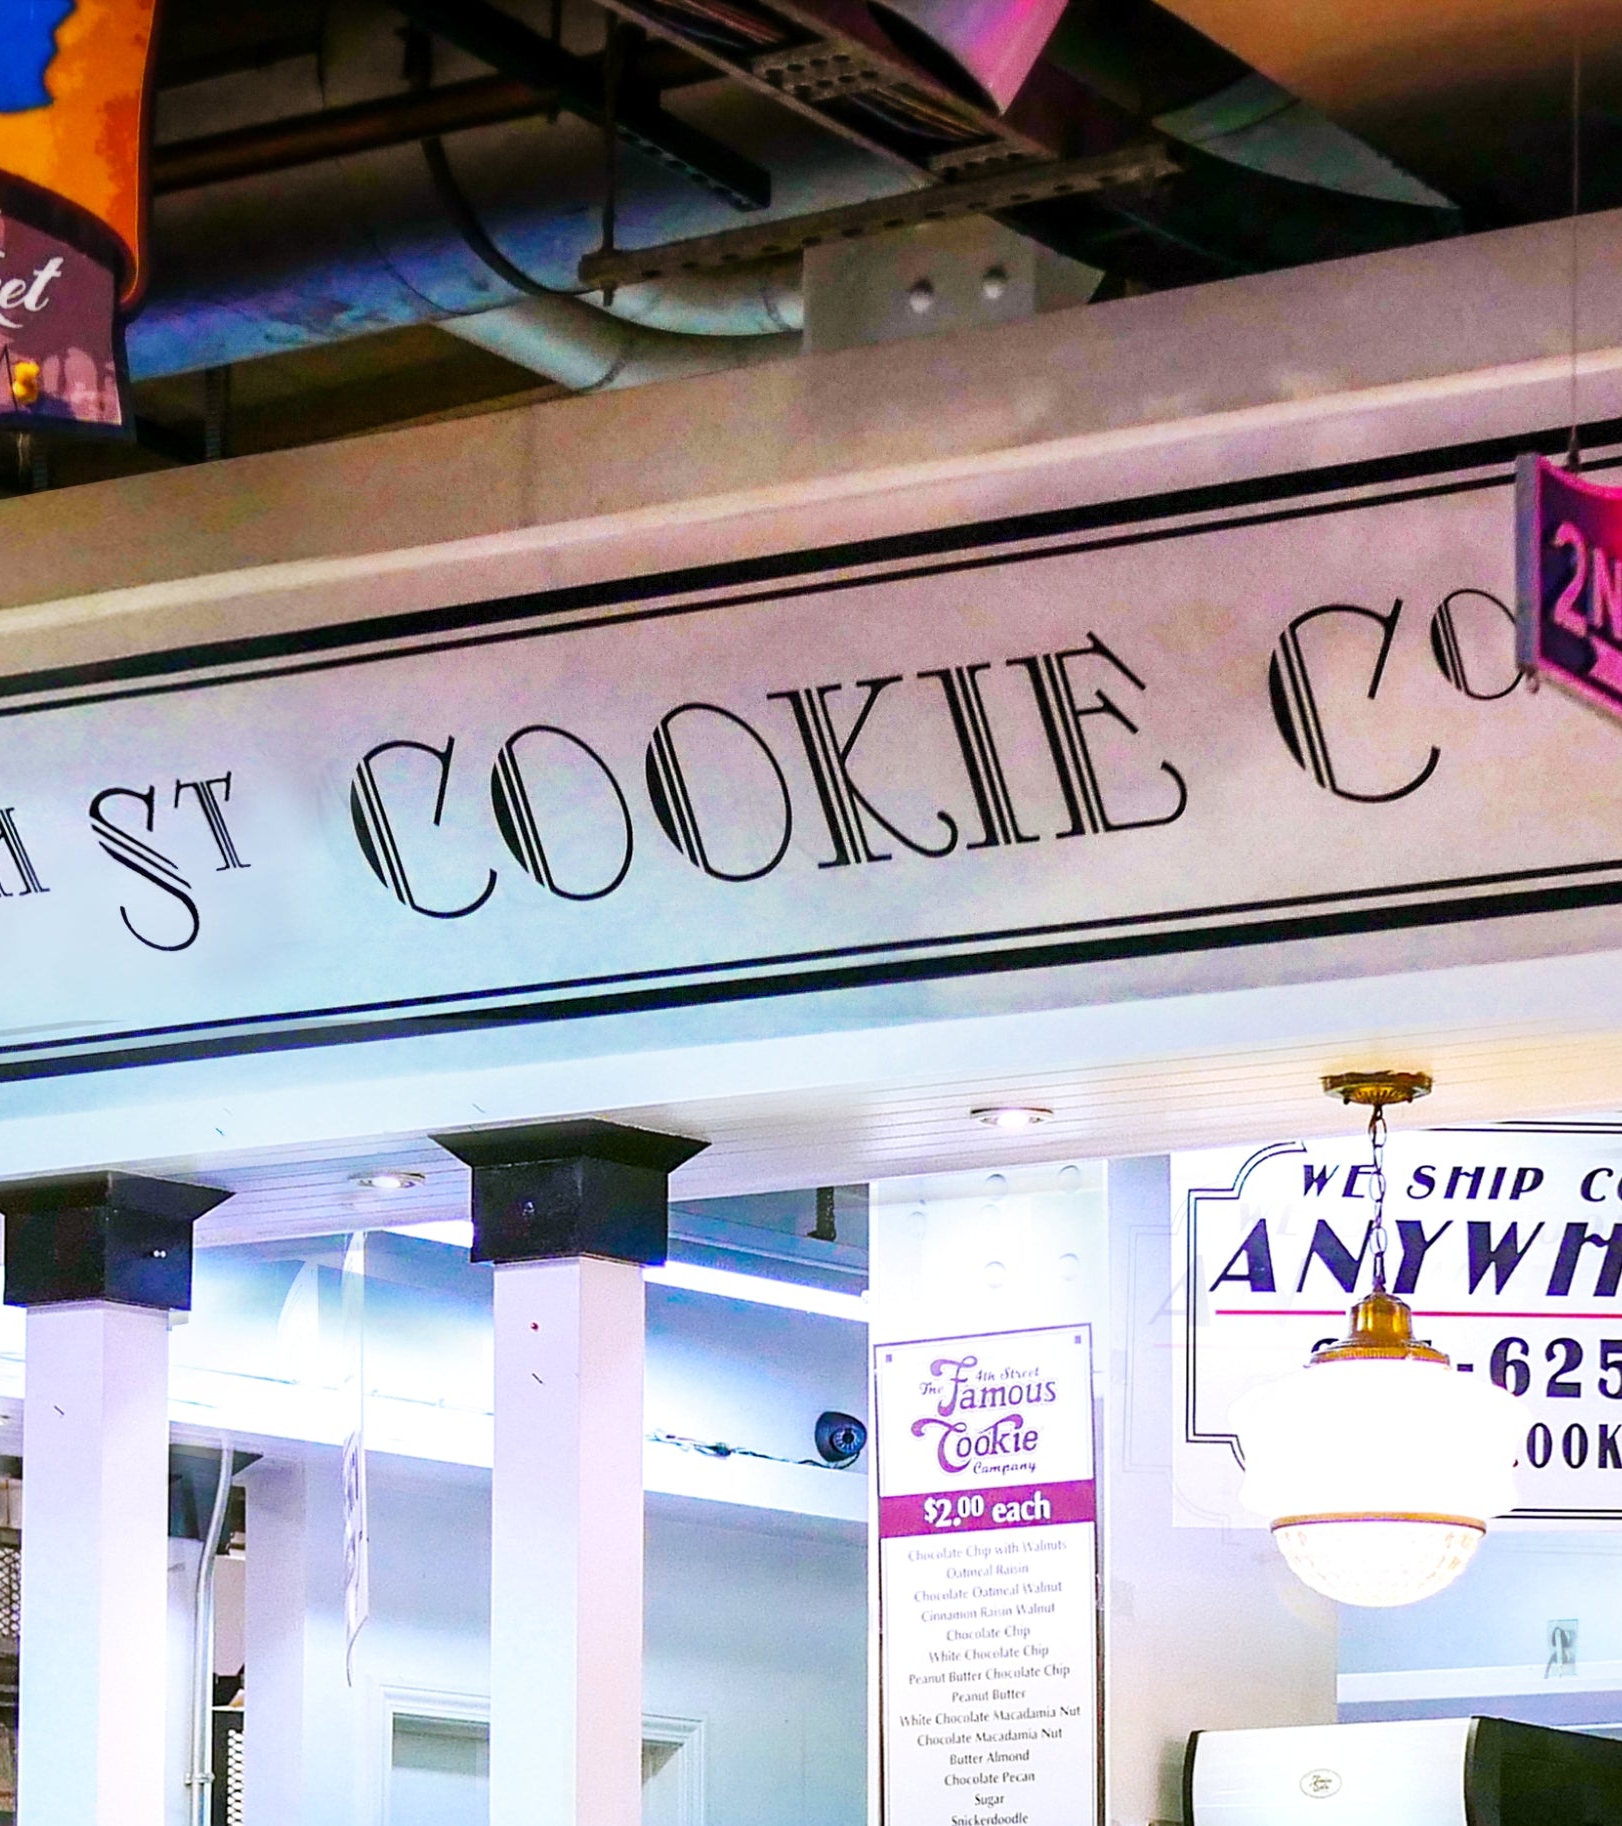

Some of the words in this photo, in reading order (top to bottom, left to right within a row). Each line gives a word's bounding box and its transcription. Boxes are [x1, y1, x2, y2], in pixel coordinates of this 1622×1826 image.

[90, 771, 250, 952] ST
[349, 631, 1187, 921] COOKIE
[1303, 1163, 1371, 1198] WE
[1407, 1165, 1545, 1201] SHIP
[1000, 1367, 1039, 1381] Street
[930, 1356, 1057, 1417] Famous
[911, 1413, 1039, 1474] Cookie
[973, 1461, 1036, 1476] Company
[924, 1495, 985, 1528] $2.00
[992, 1490, 1051, 1523] each
[908, 1546, 962, 1562] Chocolate
[965, 1543, 991, 1560] Chip
[994, 1541, 1019, 1555] with
[1022, 1539, 1067, 1553] Walnuts
[946, 1564, 993, 1579] Oatmeal
[996, 1562, 1029, 1576] Raisin
[914, 1587, 969, 1603] Chocolate
[972, 1583, 1019, 1599] Oatmeal
[1022, 1581, 1062, 1595] Walnut
[921, 1608, 977, 1623] Cinnamon
[980, 1606, 1012, 1618] Raisin
[1016, 1602, 1055, 1616] Walnut
[946, 1627, 1001, 1642] Chocolate
[1004, 1625, 1031, 1640] Chip
[929, 1649, 961, 1664] White
[964, 1646, 1020, 1661] Chocolate
[1023, 1643, 1049, 1659] Chip
[908, 1673, 946, 1686] Peanut
[948, 1671, 982, 1683] Butter
[985, 1665, 1041, 1680] Chocolate
[1043, 1663, 1071, 1679] Chip
[951, 1690, 989, 1703] Peanut
[992, 1688, 1027, 1700] Butter
[899, 1714, 932, 1728] White
[935, 1711, 990, 1726] Chocolate
[992, 1705, 1057, 1722] Macadamia
[1060, 1706, 1081, 1717] Nut
[917, 1732, 972, 1747] Chocolate
[975, 1728, 1038, 1743] Macadamia
[1041, 1727, 1063, 1739] Nut
[950, 1753, 983, 1765] Butter
[986, 1749, 1030, 1764] Almond
[944, 1773, 999, 1787] Chocolate
[1002, 1771, 1035, 1784] Pecan
[974, 1794, 1005, 1808] Sugar
